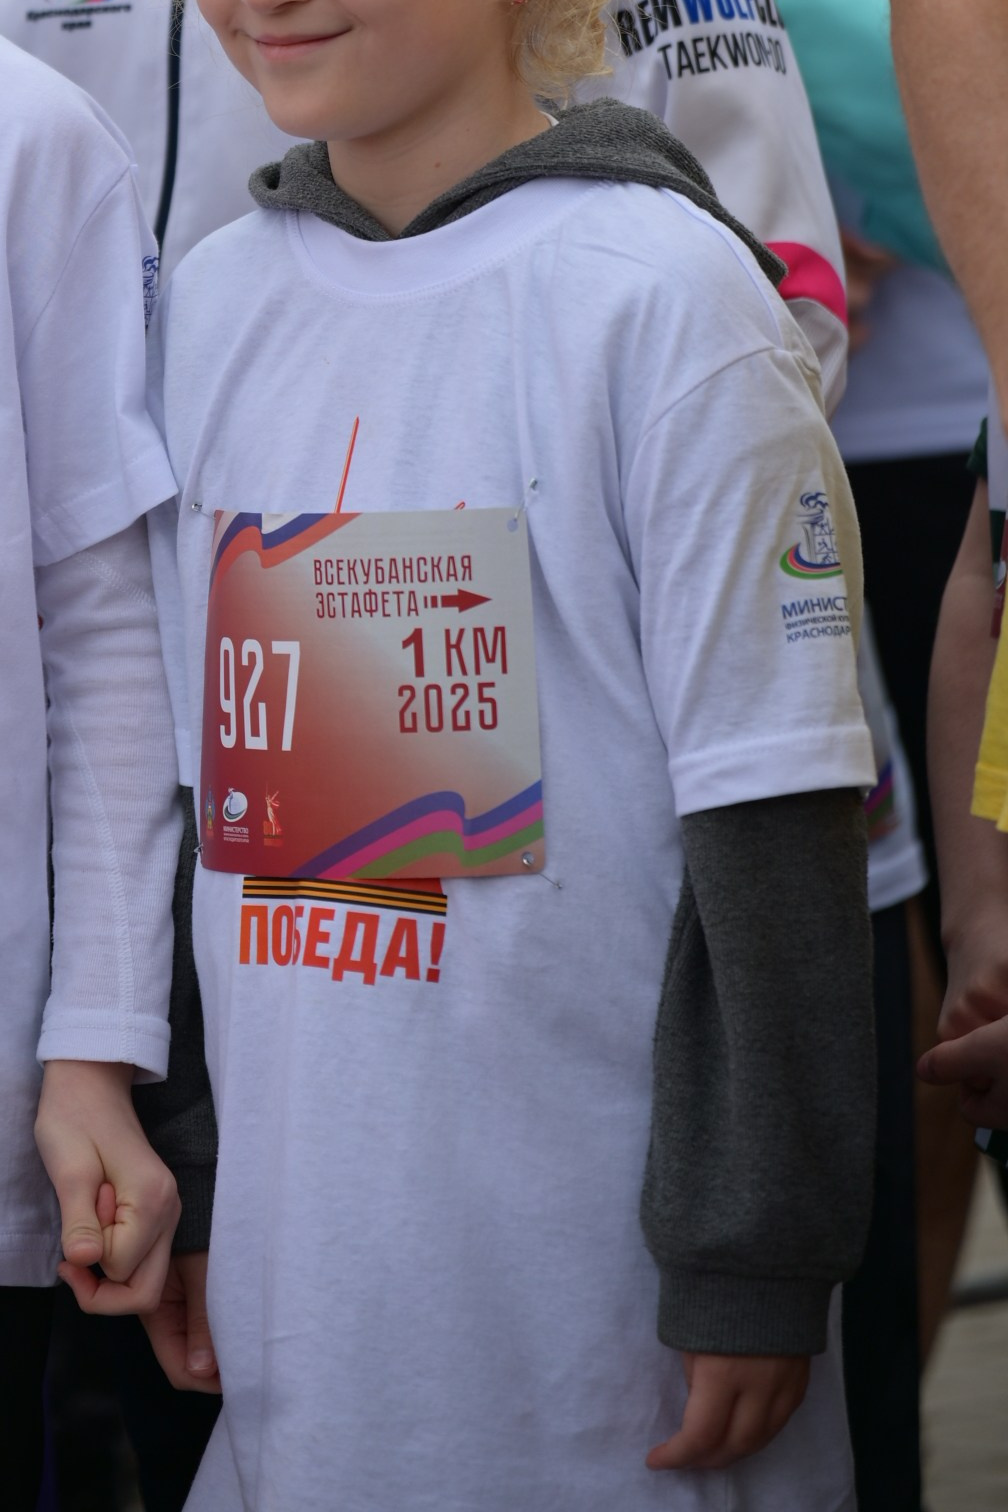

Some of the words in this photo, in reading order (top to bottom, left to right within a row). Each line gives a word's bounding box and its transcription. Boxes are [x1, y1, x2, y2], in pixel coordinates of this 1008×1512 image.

[313, 554, 472, 586] ВСЕКУБАНСКАЯ
[316, 589, 419, 619] ЭСТАФЕТА
[401, 627, 425, 678] 1
[444, 625, 508, 677] КМ
[219, 636, 301, 752] 927
[398, 682, 498, 734] 2025
